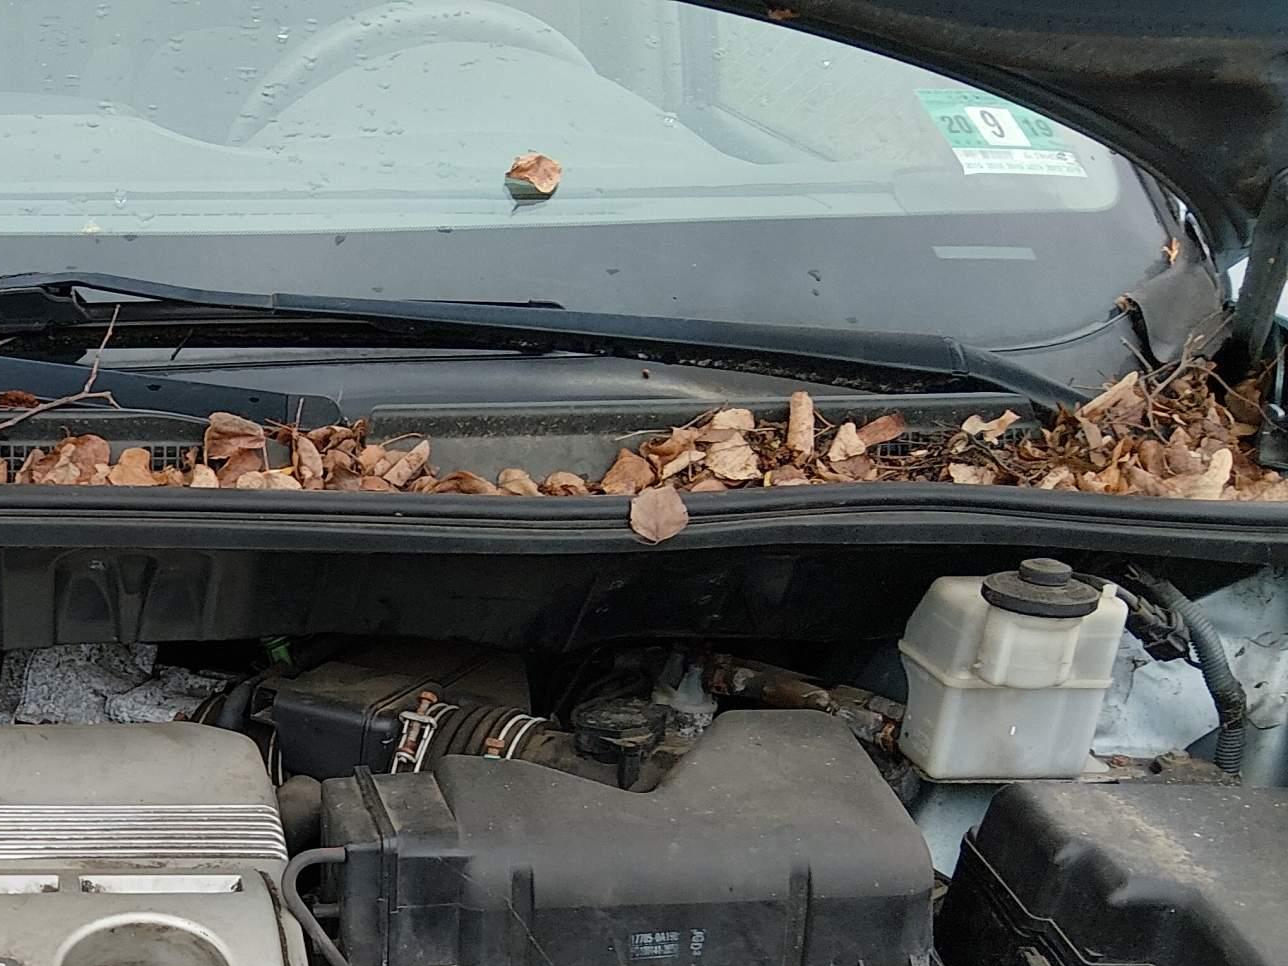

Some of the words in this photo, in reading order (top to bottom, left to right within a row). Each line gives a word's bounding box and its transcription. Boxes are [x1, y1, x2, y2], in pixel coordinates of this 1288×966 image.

[941, 114, 973, 135] 20
[980, 109, 1007, 139] 9
[1022, 118, 1055, 138] 19
